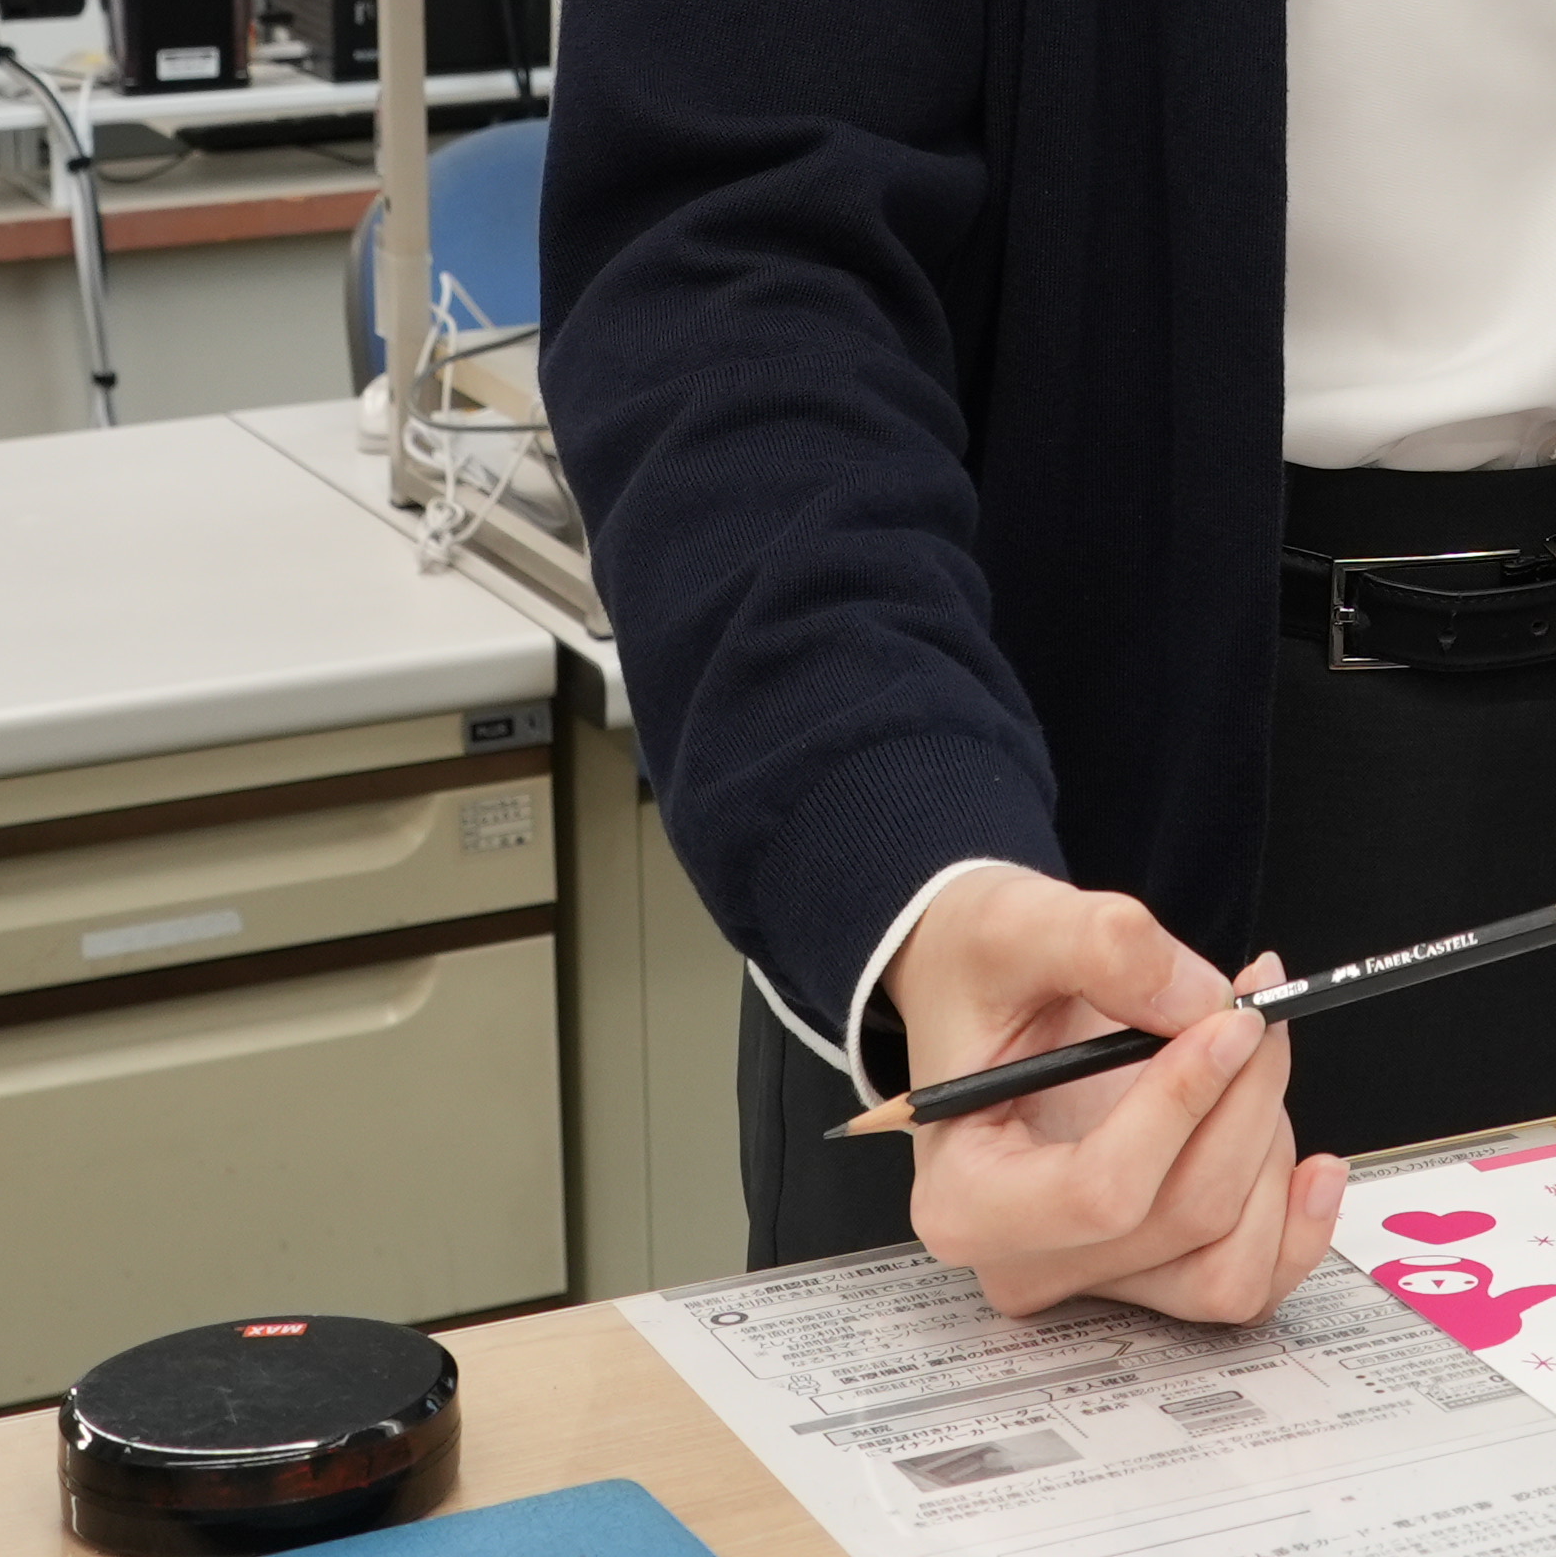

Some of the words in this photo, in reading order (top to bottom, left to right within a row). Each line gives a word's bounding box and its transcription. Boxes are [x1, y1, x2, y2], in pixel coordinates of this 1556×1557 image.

[1365, 932, 1479, 975] FABER-CASTELL
[248, 1323, 306, 1336] MAX
[1060, 1372, 1140, 1394] 本人確認
